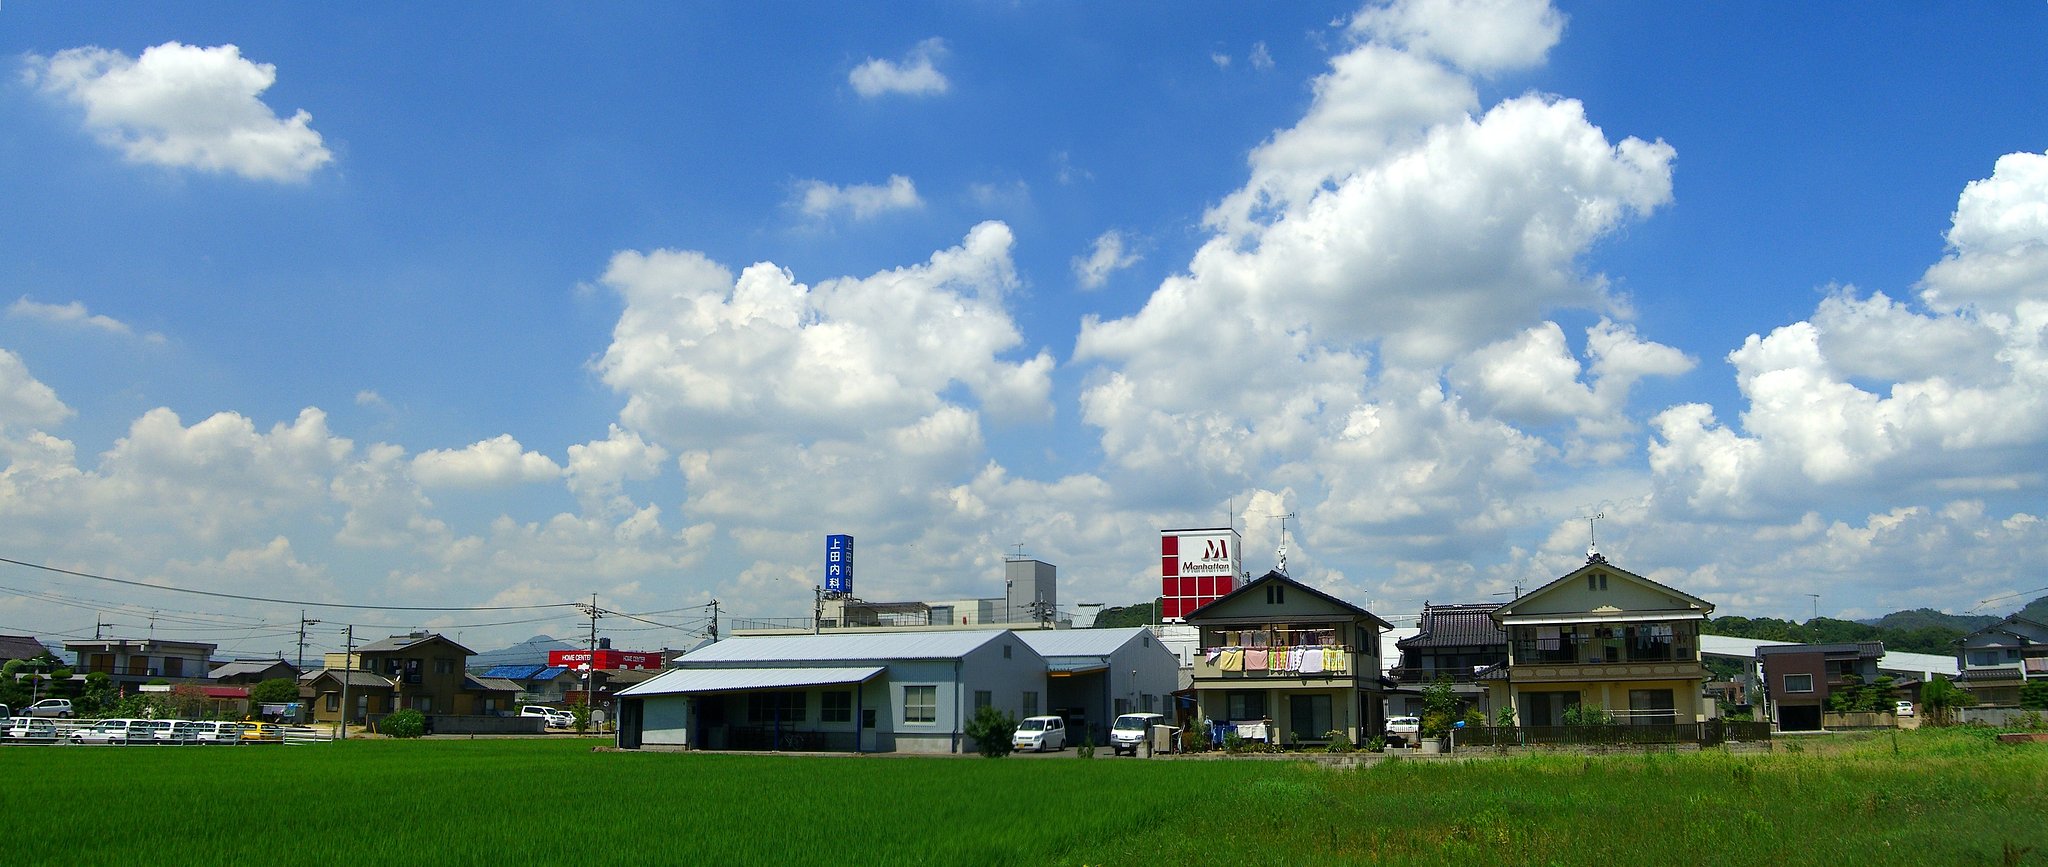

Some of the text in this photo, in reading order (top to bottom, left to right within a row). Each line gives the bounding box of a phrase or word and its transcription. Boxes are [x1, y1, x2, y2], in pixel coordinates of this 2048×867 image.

[829, 538, 841, 589] 上田内科
[1182, 561, 1230, 571] Manhattan
